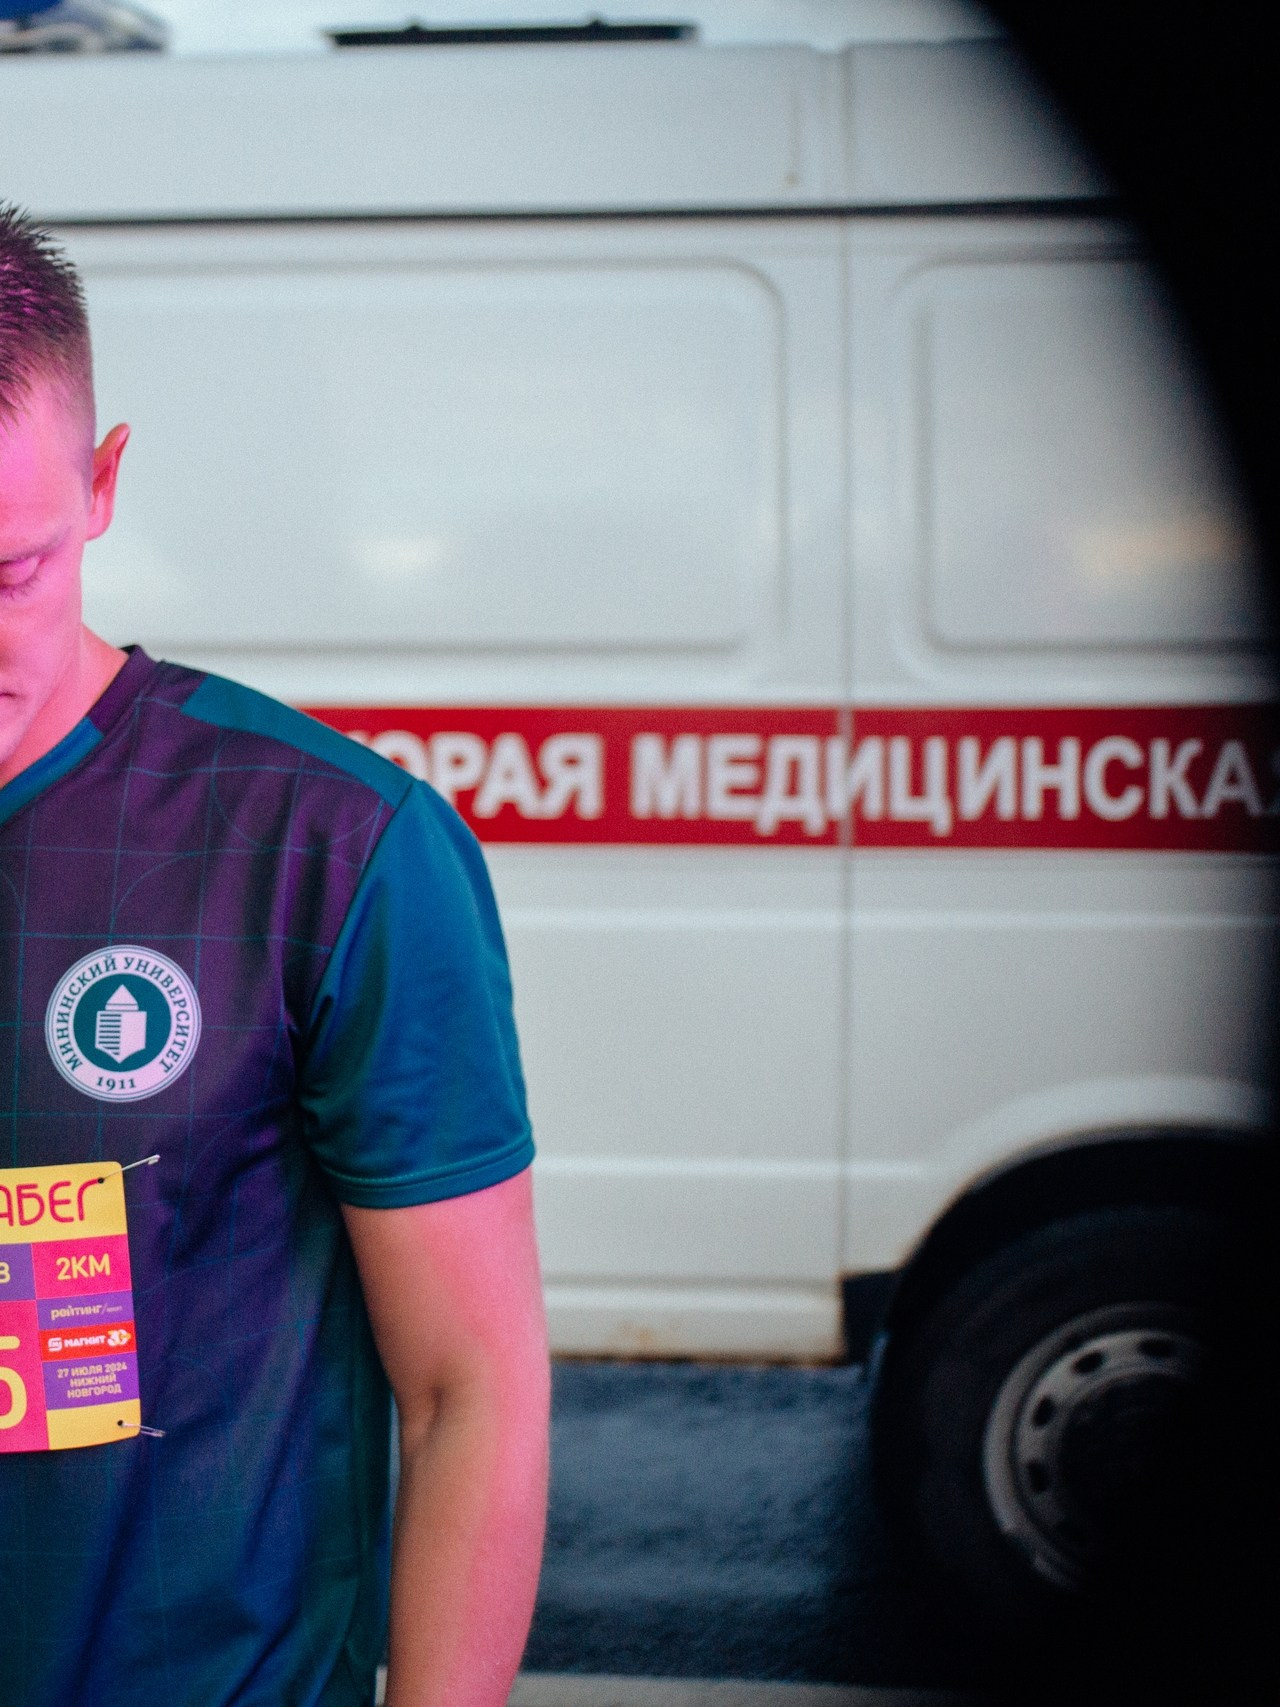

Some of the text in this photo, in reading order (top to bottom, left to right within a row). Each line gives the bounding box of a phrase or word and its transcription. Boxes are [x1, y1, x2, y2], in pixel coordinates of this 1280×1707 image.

[348, 730, 1280, 838] РАЯ МЕДИЦИНСКА
[56, 954, 191, 1073] МИНИНСКИЙ УНИВЕРСИТЕТ
[96, 1076, 137, 1092] 1911
[55, 1253, 111, 1281] 2КМ
[57, 1368, 69, 1379] 27
[104, 1361, 128, 1373] 2024
[69, 1371, 117, 1388] НИЖНИЙ
[66, 1383, 122, 1399] НОВГОРОД
